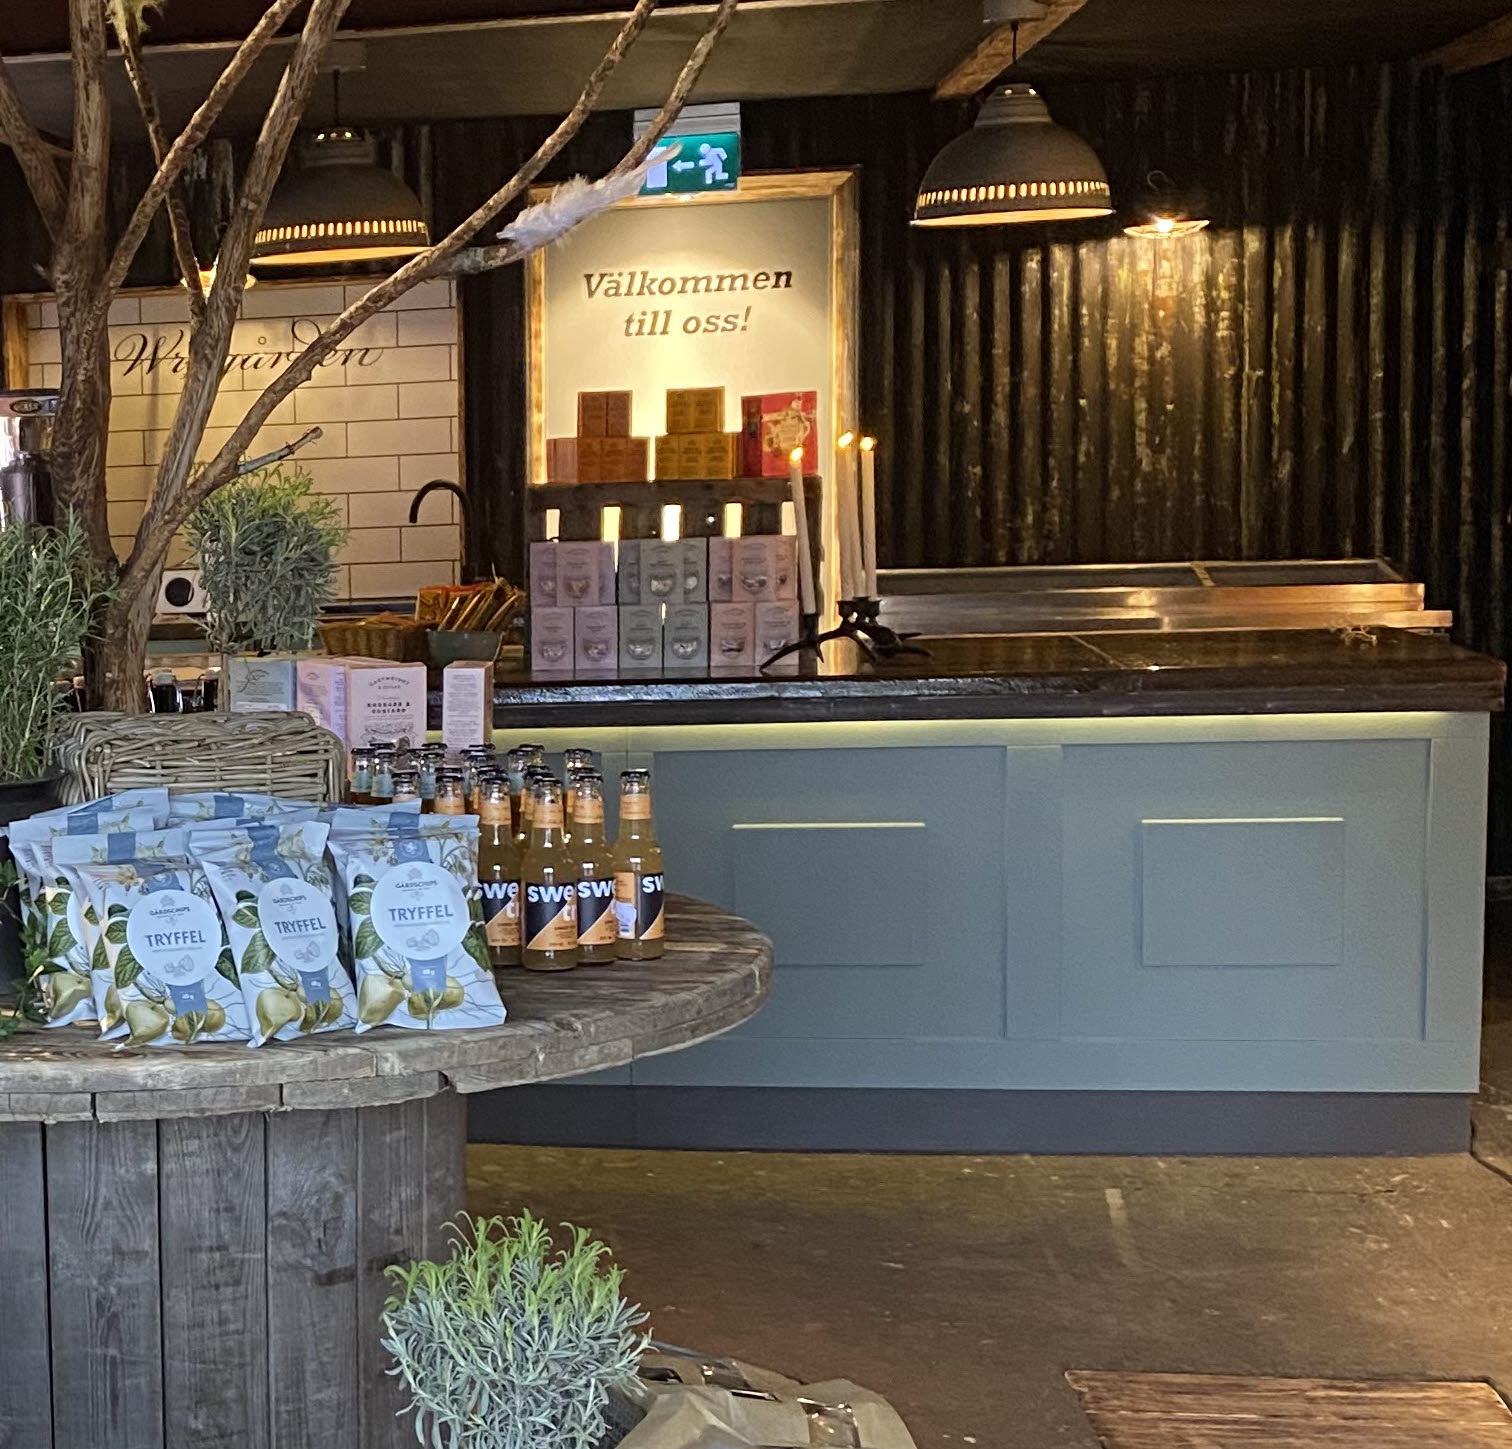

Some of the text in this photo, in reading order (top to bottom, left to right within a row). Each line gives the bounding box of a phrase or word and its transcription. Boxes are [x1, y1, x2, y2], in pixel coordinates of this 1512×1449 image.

[584, 269, 794, 299] Välkommen
[623, 306, 752, 338] till oss!
[389, 904, 454, 921] TRYFFEL
[274, 917, 327, 935] TRYFFEL
[145, 932, 206, 948] TRYFFEL
